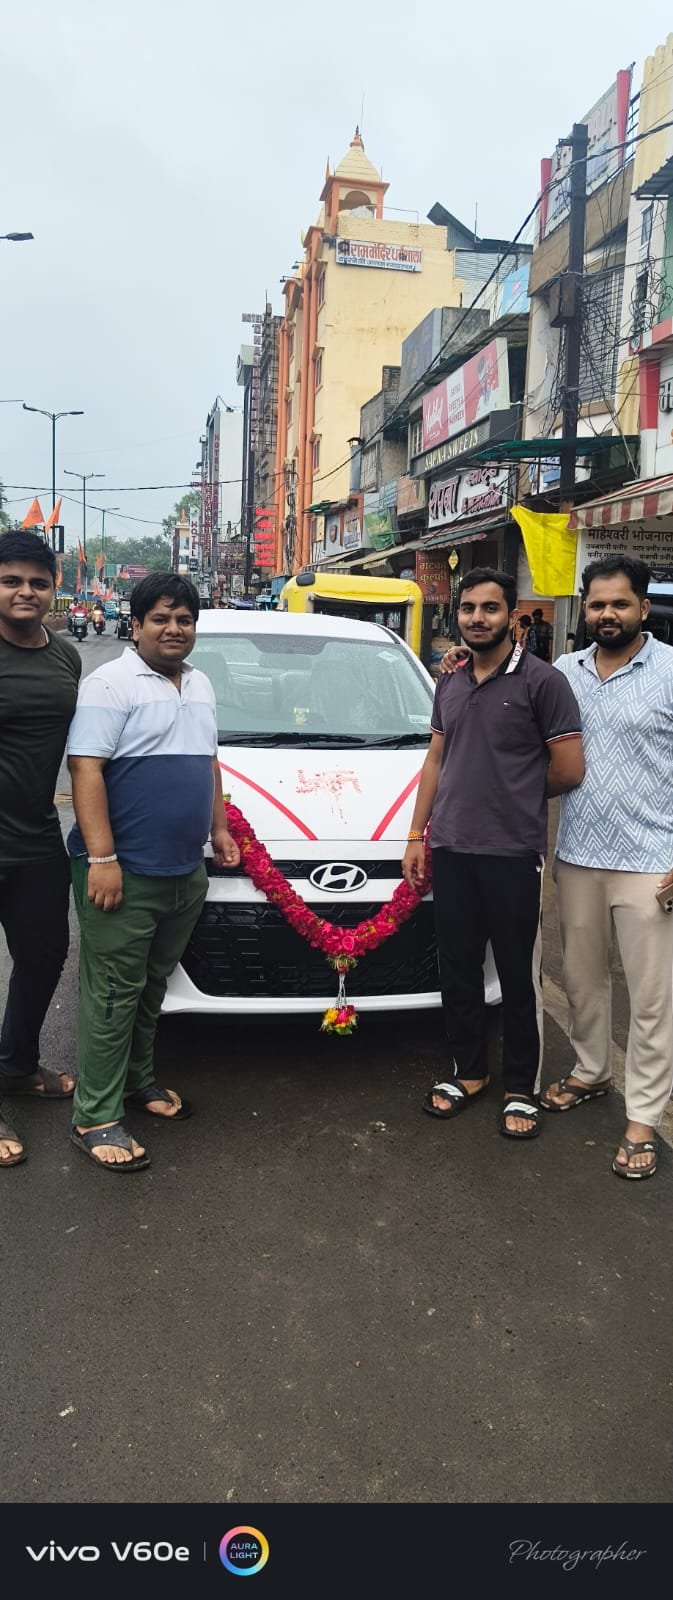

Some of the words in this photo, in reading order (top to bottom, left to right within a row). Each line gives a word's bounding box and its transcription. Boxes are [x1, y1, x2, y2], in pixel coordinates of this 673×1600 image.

[425, 448, 447, 471] SAPNA
[447, 430, 478, 458] SWEETS
[588, 526, 629, 541] माहेश्वरी
